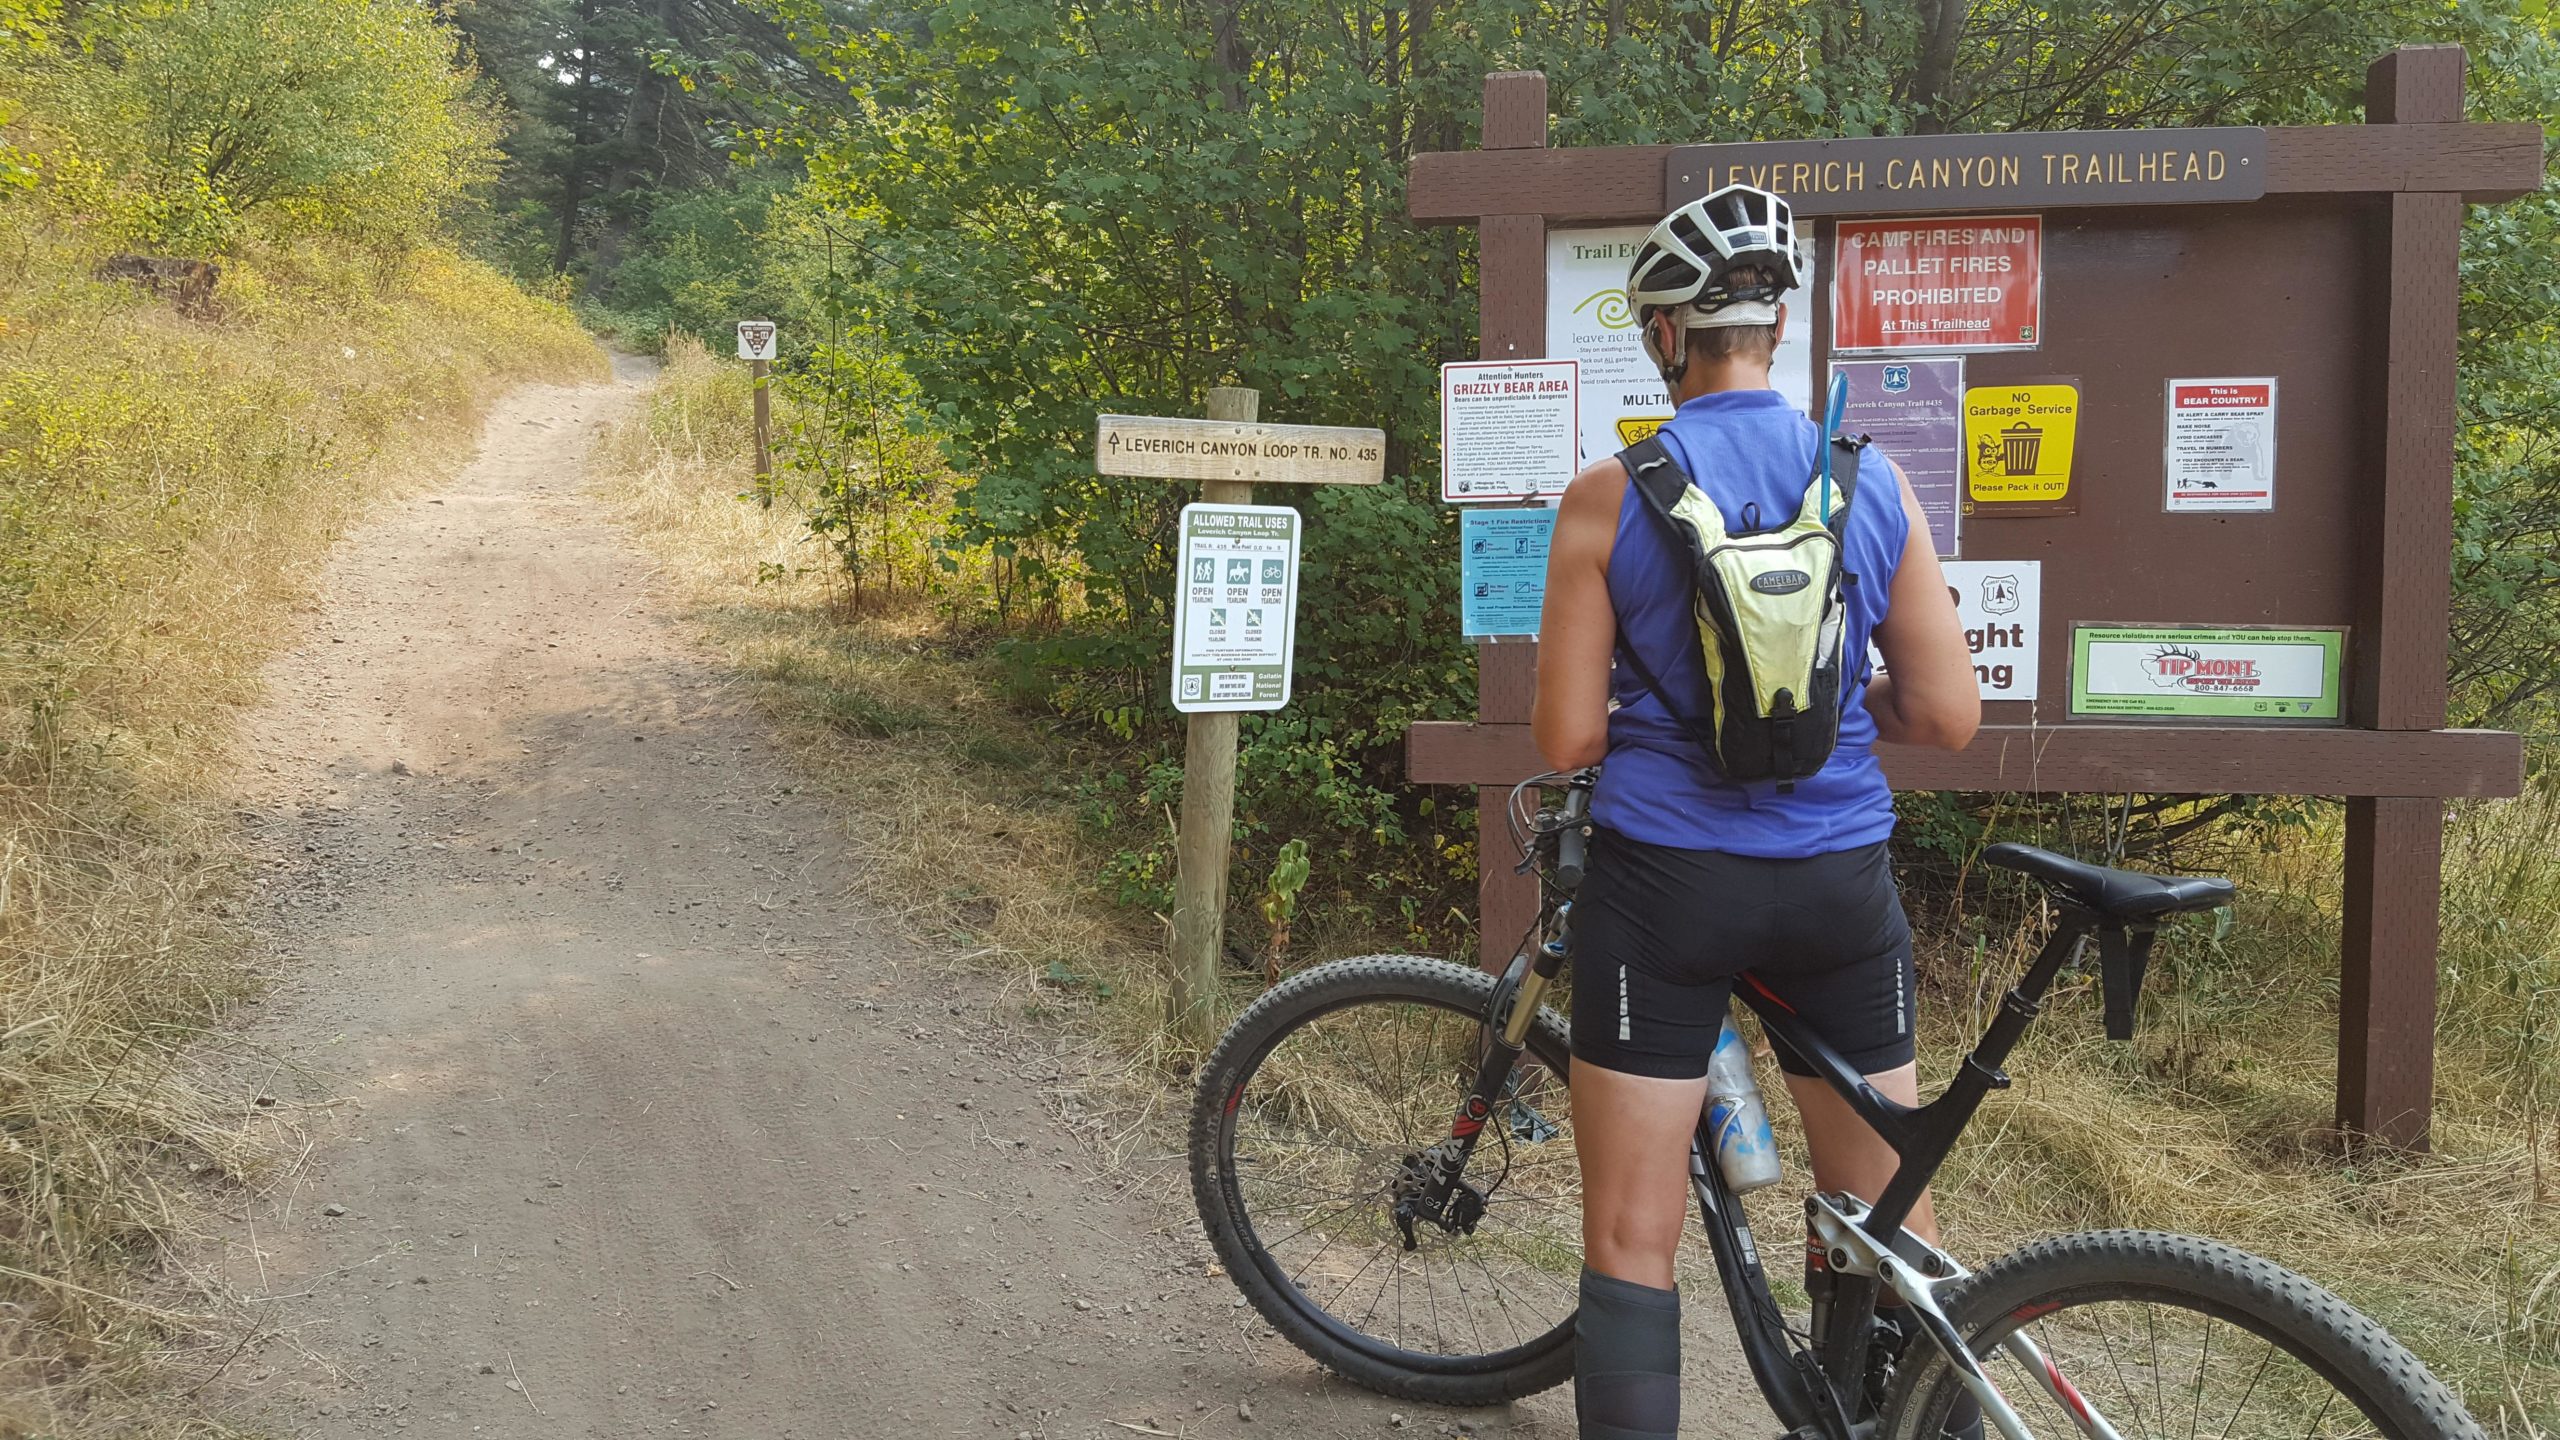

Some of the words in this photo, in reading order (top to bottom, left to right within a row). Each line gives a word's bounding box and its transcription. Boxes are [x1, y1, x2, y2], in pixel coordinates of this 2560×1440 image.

[1707, 160, 1865, 194] LEVERICH
[1886, 155, 2020, 190] CANYON
[2041, 150, 2226, 185] TRAILHEAD
[1851, 228, 1974, 249] CAMPFIRES
[1980, 227, 2026, 244] AND
[1572, 243, 1613, 260] Trail
[1618, 242, 1638, 258] Et
[1864, 257, 1944, 276] PALLET
[1950, 255, 2012, 273] FIRES
[1872, 286, 2002, 306] PROHIBITED
[1881, 320, 1896, 332] At
[1899, 319, 1927, 331] This
[1930, 317, 1991, 330] Trailhead
[1572, 332, 1605, 343] leave
[1607, 333, 1624, 342] no
[1478, 372, 1512, 381] Attention
[1514, 371, 1544, 380] Hunters
[1453, 382, 1500, 396] GRIZZLY
[1504, 381, 1535, 394] BEAR
[1538, 380, 1569, 392] AREA
[2209, 387, 2228, 395] This
[1491, 394, 1531, 402] unpredictable
[1538, 393, 1568, 401] dangerous
[1846, 400, 1877, 409] Leverich
[1878, 400, 1905, 409] Canyon
[2012, 392, 2031, 403] NO
[2183, 397, 2209, 405] BEAR
[2211, 396, 2258, 405] COUNTRY
[1969, 405, 2021, 417] Garbage
[2027, 404, 2073, 415] Service
[1125, 437, 1196, 454] LEVERICH
[1200, 441, 1257, 456] CANYON
[1263, 443, 1298, 458] LOOP
[1303, 445, 1323, 459] TR.
[1329, 447, 1351, 460] NO.
[1357, 448, 1377, 461] 435
[1973, 483, 2003, 491] Please
[2007, 483, 2029, 491] Pack
[2033, 482, 2040, 490] it
[2043, 482, 2065, 490] OUT!
[1193, 514, 1235, 527] ALLOWED
[1237, 515, 1263, 528] TRAIL
[1264, 517, 1288, 529] USES
[1756, 573, 1805, 589] CAMELBAK
[1192, 587, 1214, 595] OPEN
[1226, 588, 1248, 596] OPEN
[1261, 588, 1282, 597] OPEN
[2159, 658, 2193, 676] TIP
[2195, 659, 2257, 677] MONT
[1424, 1196, 1442, 1211] G2
